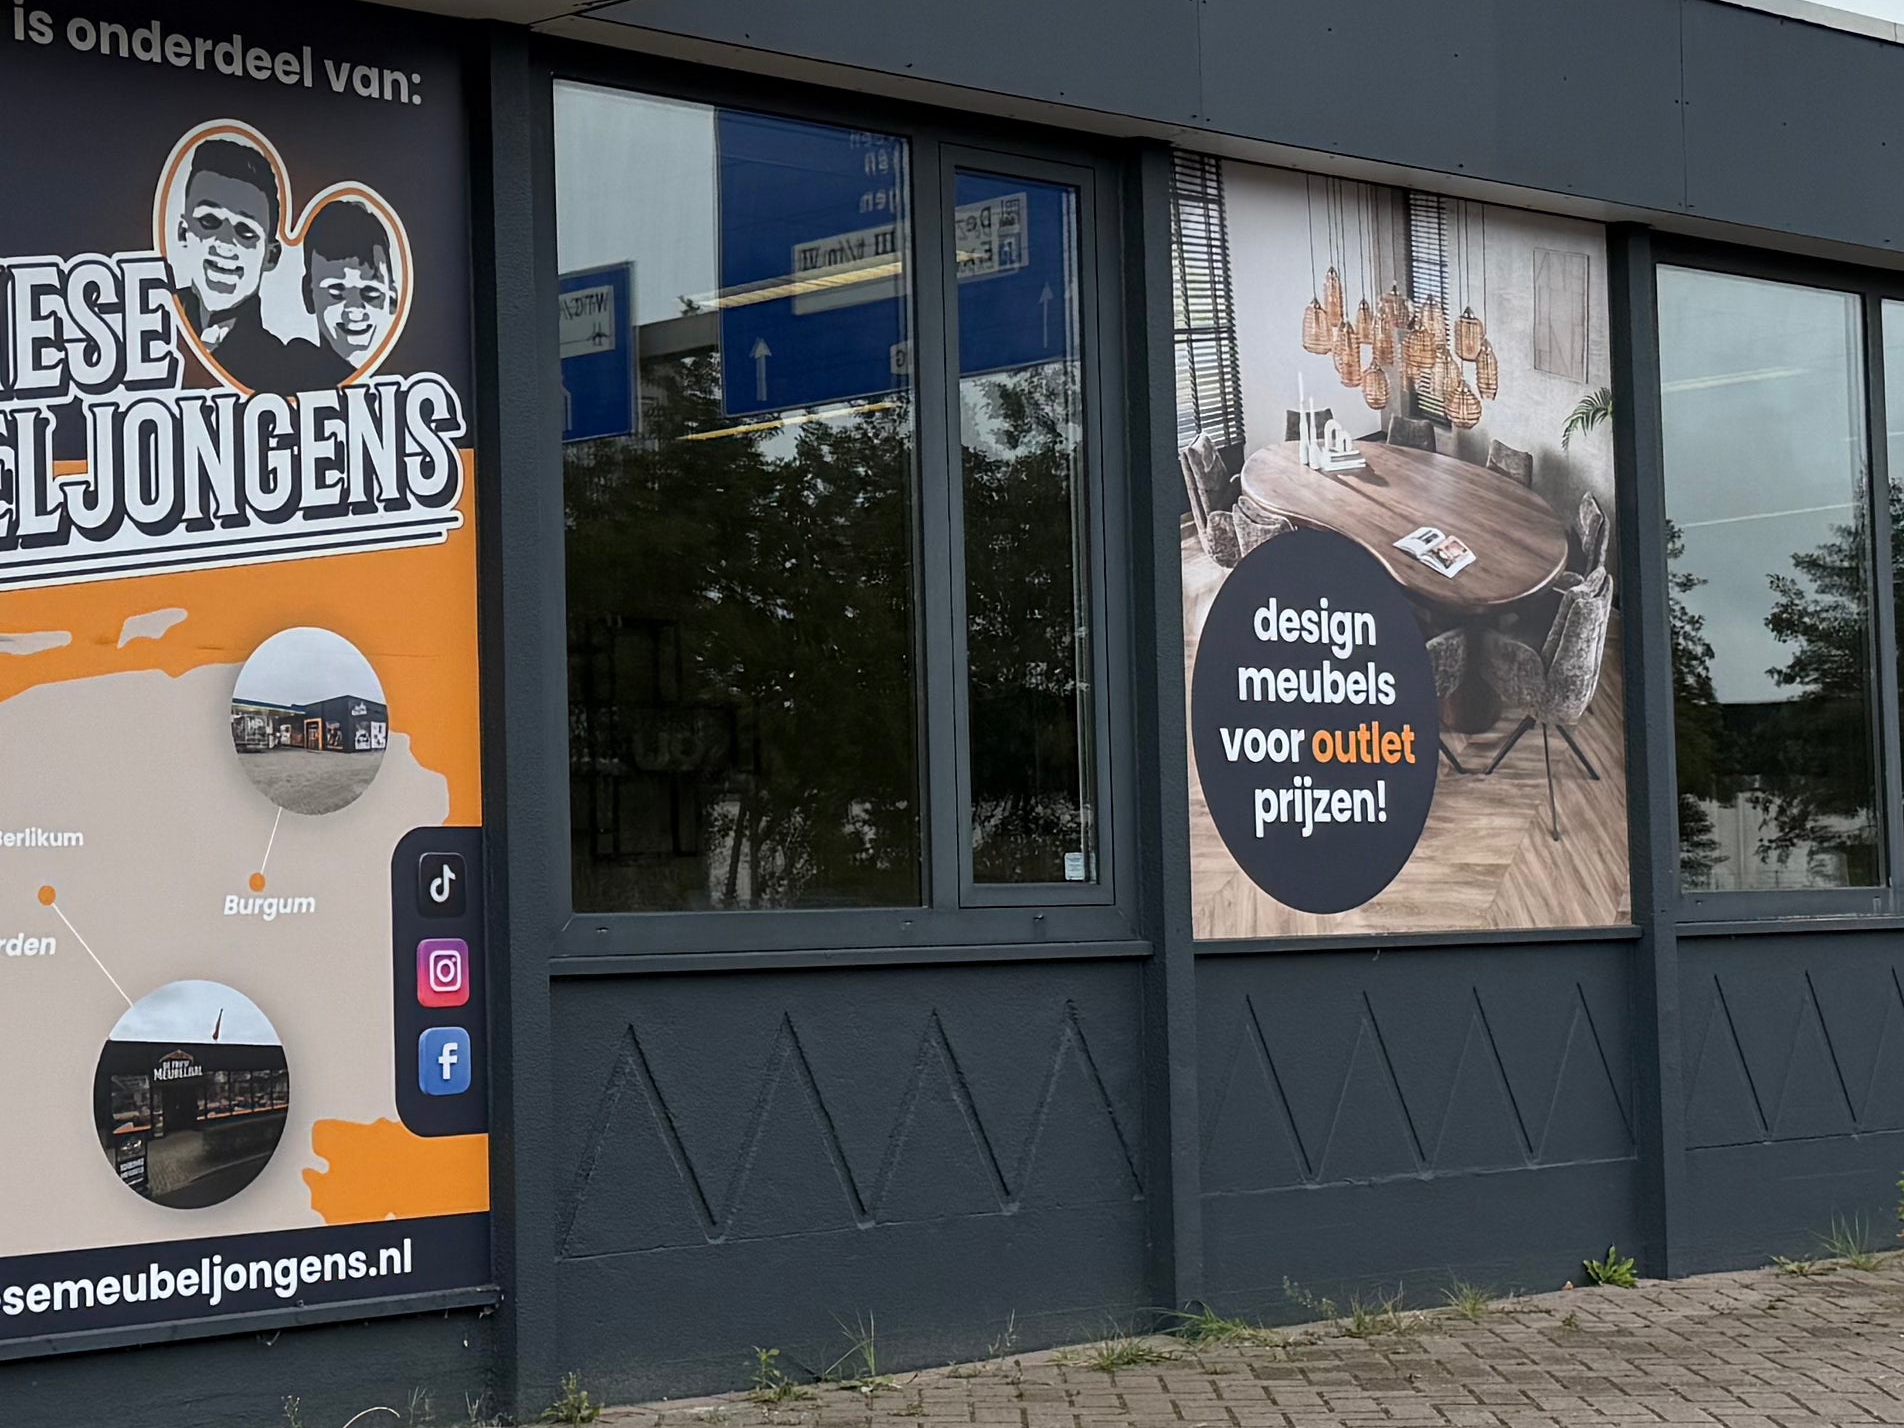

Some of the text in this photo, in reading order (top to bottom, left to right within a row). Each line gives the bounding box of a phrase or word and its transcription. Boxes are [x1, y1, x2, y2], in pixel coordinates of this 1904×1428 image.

[66, 17, 313, 88] onderdeel
[323, 58, 422, 106] van:
[1253, 597, 1376, 659] design
[1237, 660, 1396, 705] meubels
[1219, 721, 1416, 764] voor outlet
[1253, 775, 1388, 838] prijzen!
[223, 894, 316, 922] Burgum
